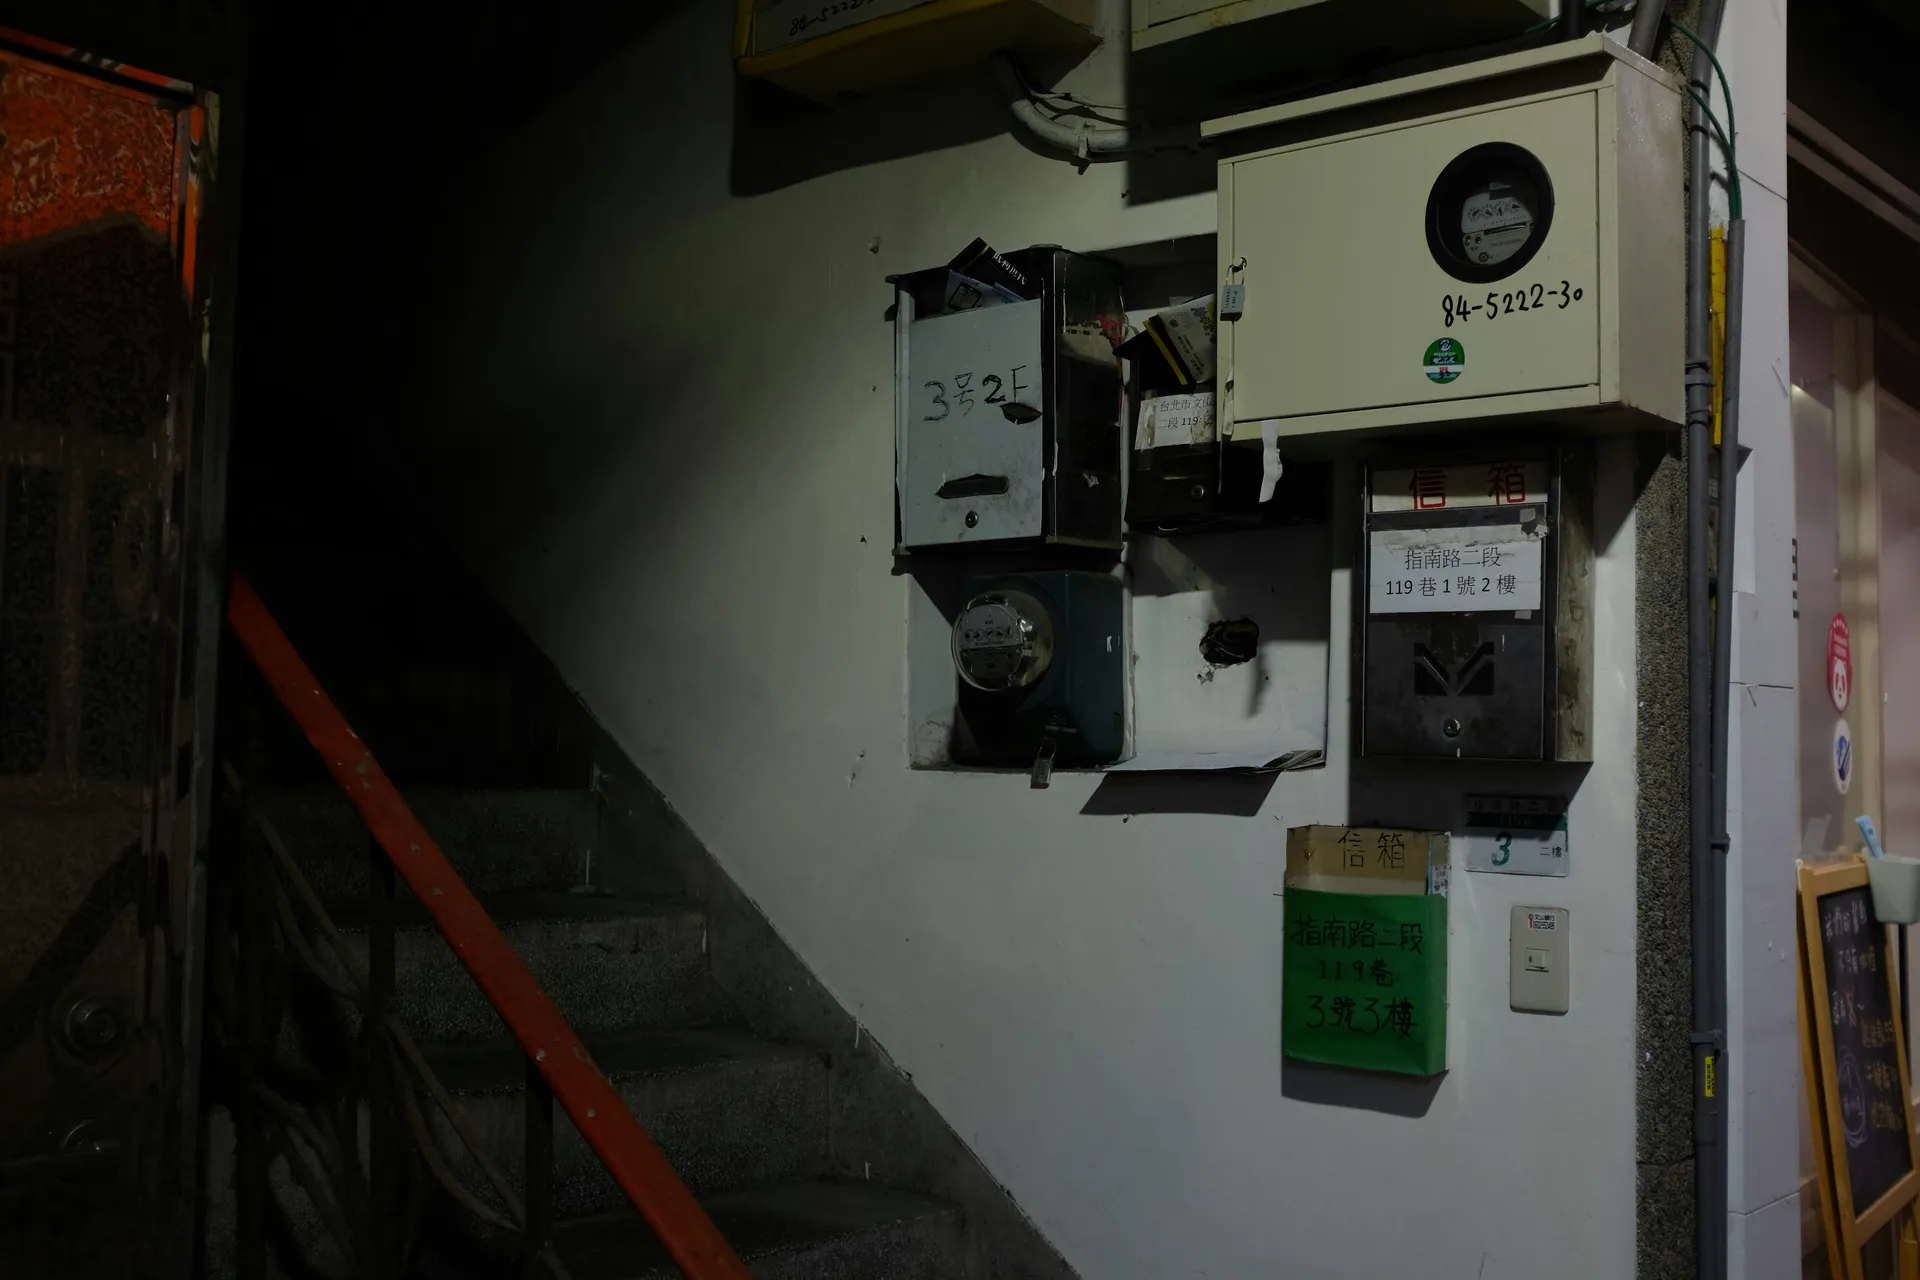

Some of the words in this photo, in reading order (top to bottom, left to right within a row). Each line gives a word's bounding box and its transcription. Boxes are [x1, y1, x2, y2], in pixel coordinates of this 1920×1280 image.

[789, 0, 874, 36] 84-5222-
[1442, 280, 1583, 327] 84-5222-30
[1409, 464, 1526, 511] 信箱
[1405, 547, 1502, 570] 指南路二段
[1338, 831, 1406, 870] 信箱
[1491, 832, 1513, 866] 3
[1291, 914, 1423, 955] 指南路二段
[1305, 994, 1418, 1039] 3號3樓
